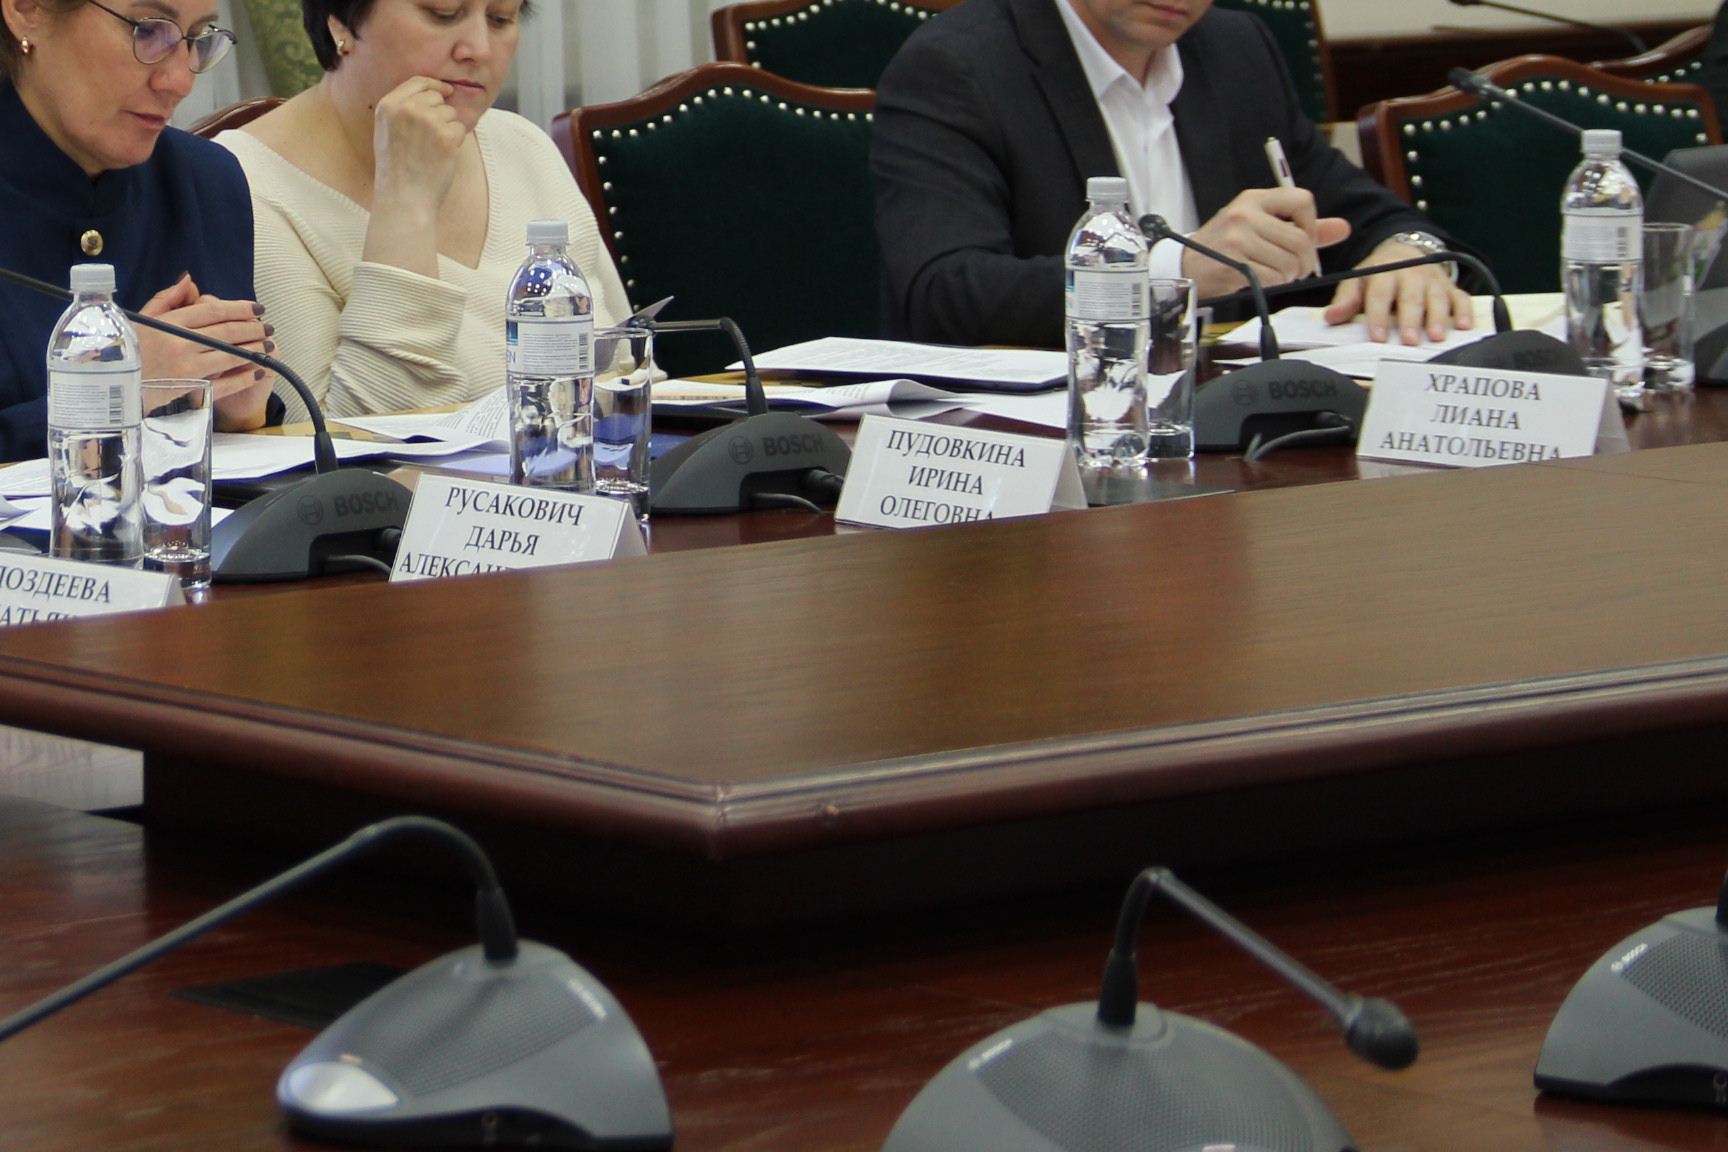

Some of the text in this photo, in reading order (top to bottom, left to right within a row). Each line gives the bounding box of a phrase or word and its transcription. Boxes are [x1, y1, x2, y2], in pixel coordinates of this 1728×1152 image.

[1267, 378, 1337, 400] BOSCH
[1424, 373, 1541, 401] ХРАПОВА
[1429, 404, 1521, 430] ЛИАНА
[761, 432, 824, 457] BOSCH
[886, 430, 1026, 468] ПУДОВКИНА
[1379, 431, 1562, 462] АНАТОЛЬЕВНА
[907, 465, 984, 496] ИРИНА
[333, 490, 400, 517] BOSCH
[444, 486, 585, 527] РУСАКОВИЧ
[463, 524, 540, 556] ДАРЬЯ
